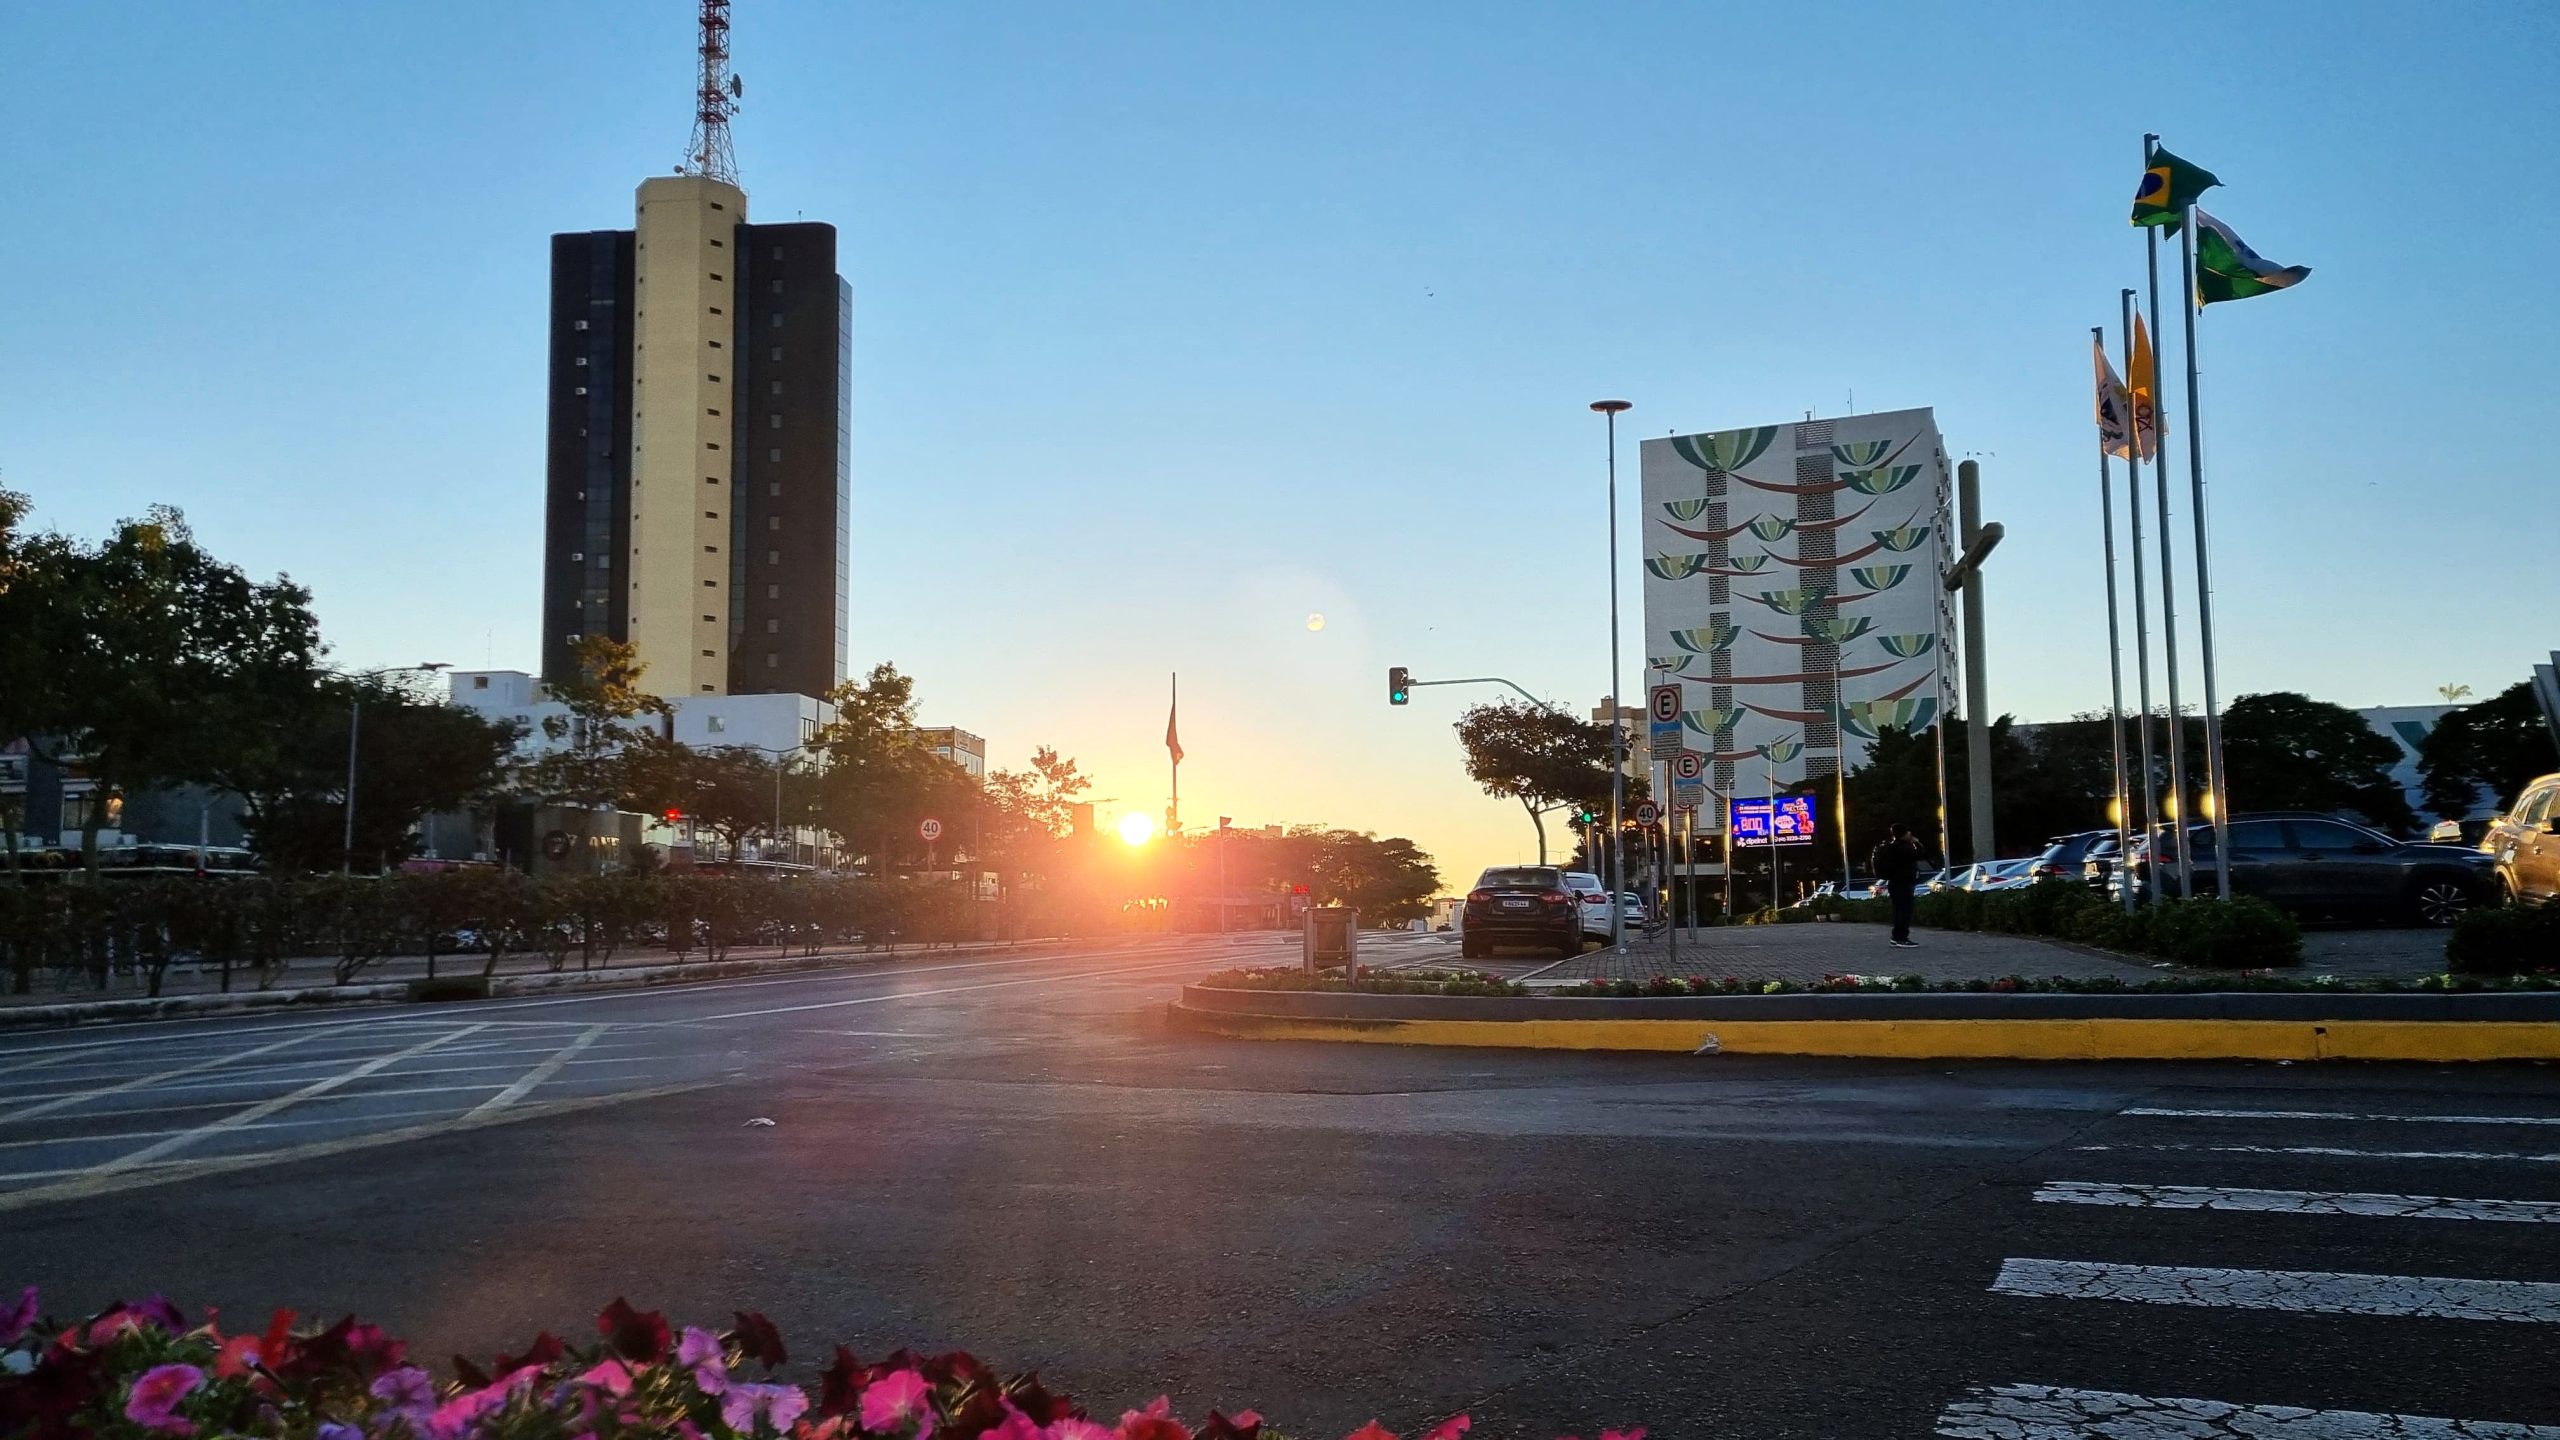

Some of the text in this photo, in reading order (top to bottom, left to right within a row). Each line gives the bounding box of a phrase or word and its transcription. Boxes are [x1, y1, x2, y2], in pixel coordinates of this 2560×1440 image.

[1661, 695, 1671, 716] E
[1683, 758, 1693, 774] E
[1638, 807, 1654, 819] 40
[923, 822, 938, 833] 40
